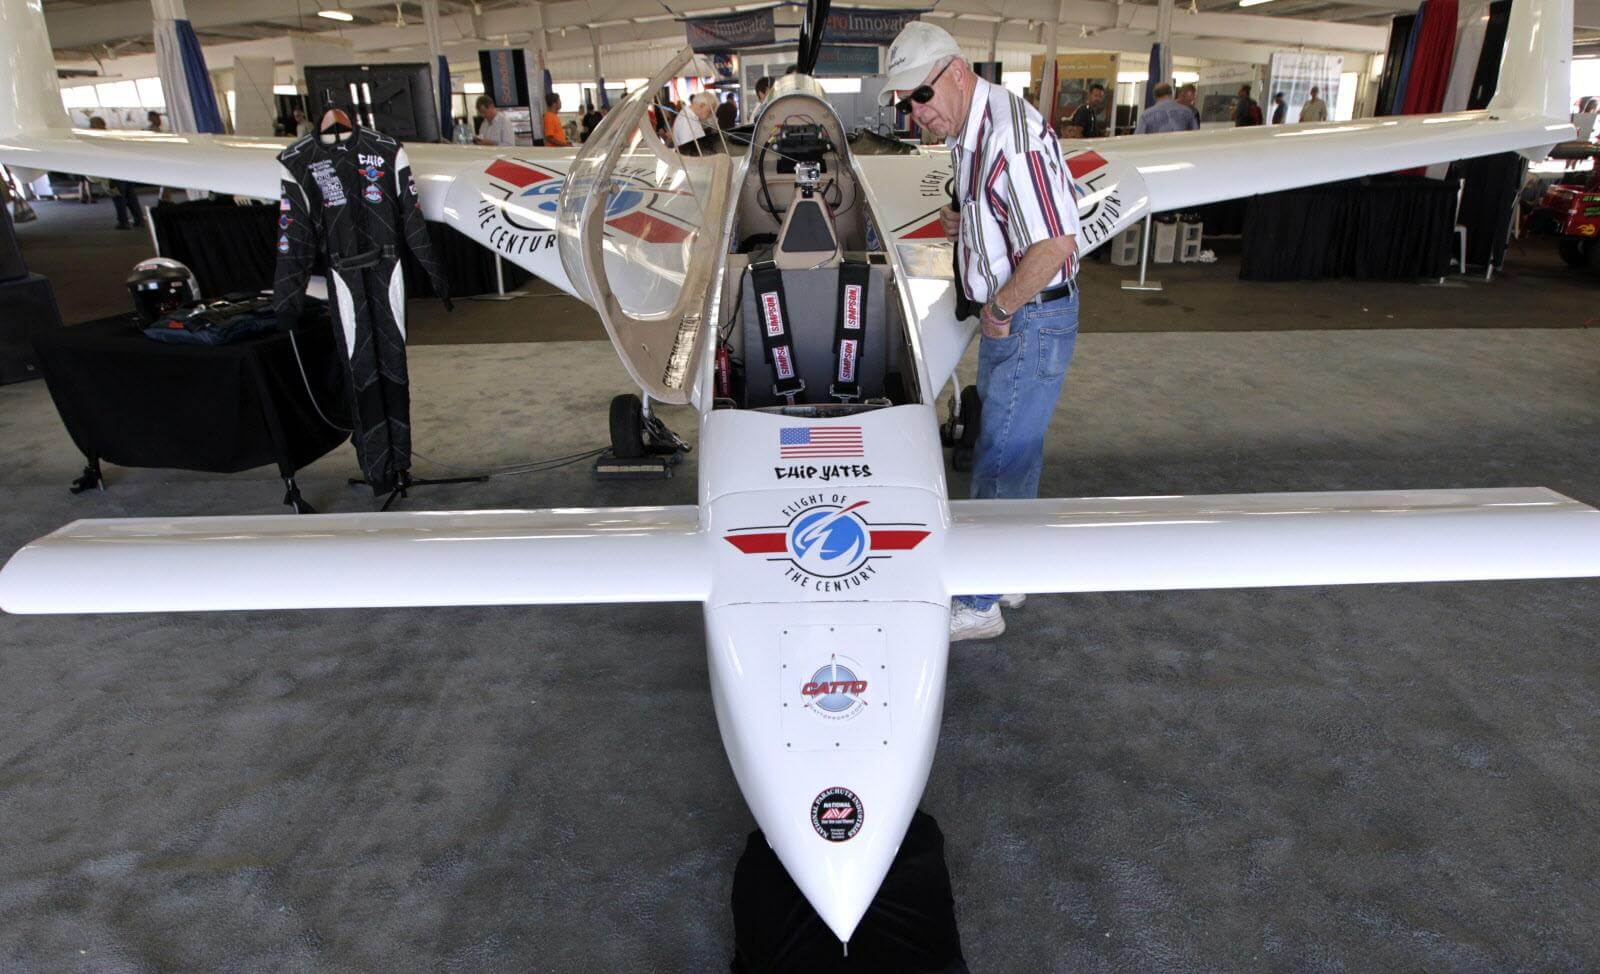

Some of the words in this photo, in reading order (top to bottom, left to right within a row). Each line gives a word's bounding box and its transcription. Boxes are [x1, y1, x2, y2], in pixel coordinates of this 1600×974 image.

[358, 153, 385, 168] CHIP
[920, 169, 949, 197] FLIGHT
[490, 224, 557, 254] CENTUR
[766, 296, 780, 332] SIMPSON
[848, 288, 858, 326] SIMPSON
[777, 345, 790, 375] SIMPSO
[843, 342, 853, 379] SIMPSON
[774, 466, 818, 480] CHIP
[819, 464, 873, 481] YATES
[782, 493, 825, 517] FLIGHT
[832, 494, 848, 504] OF
[784, 566, 809, 587] THE
[815, 565, 877, 593] CENTURY
[802, 680, 868, 696] CATTO
[816, 788, 854, 805] PARACHUTE
[811, 805, 828, 838] NATIONAL
